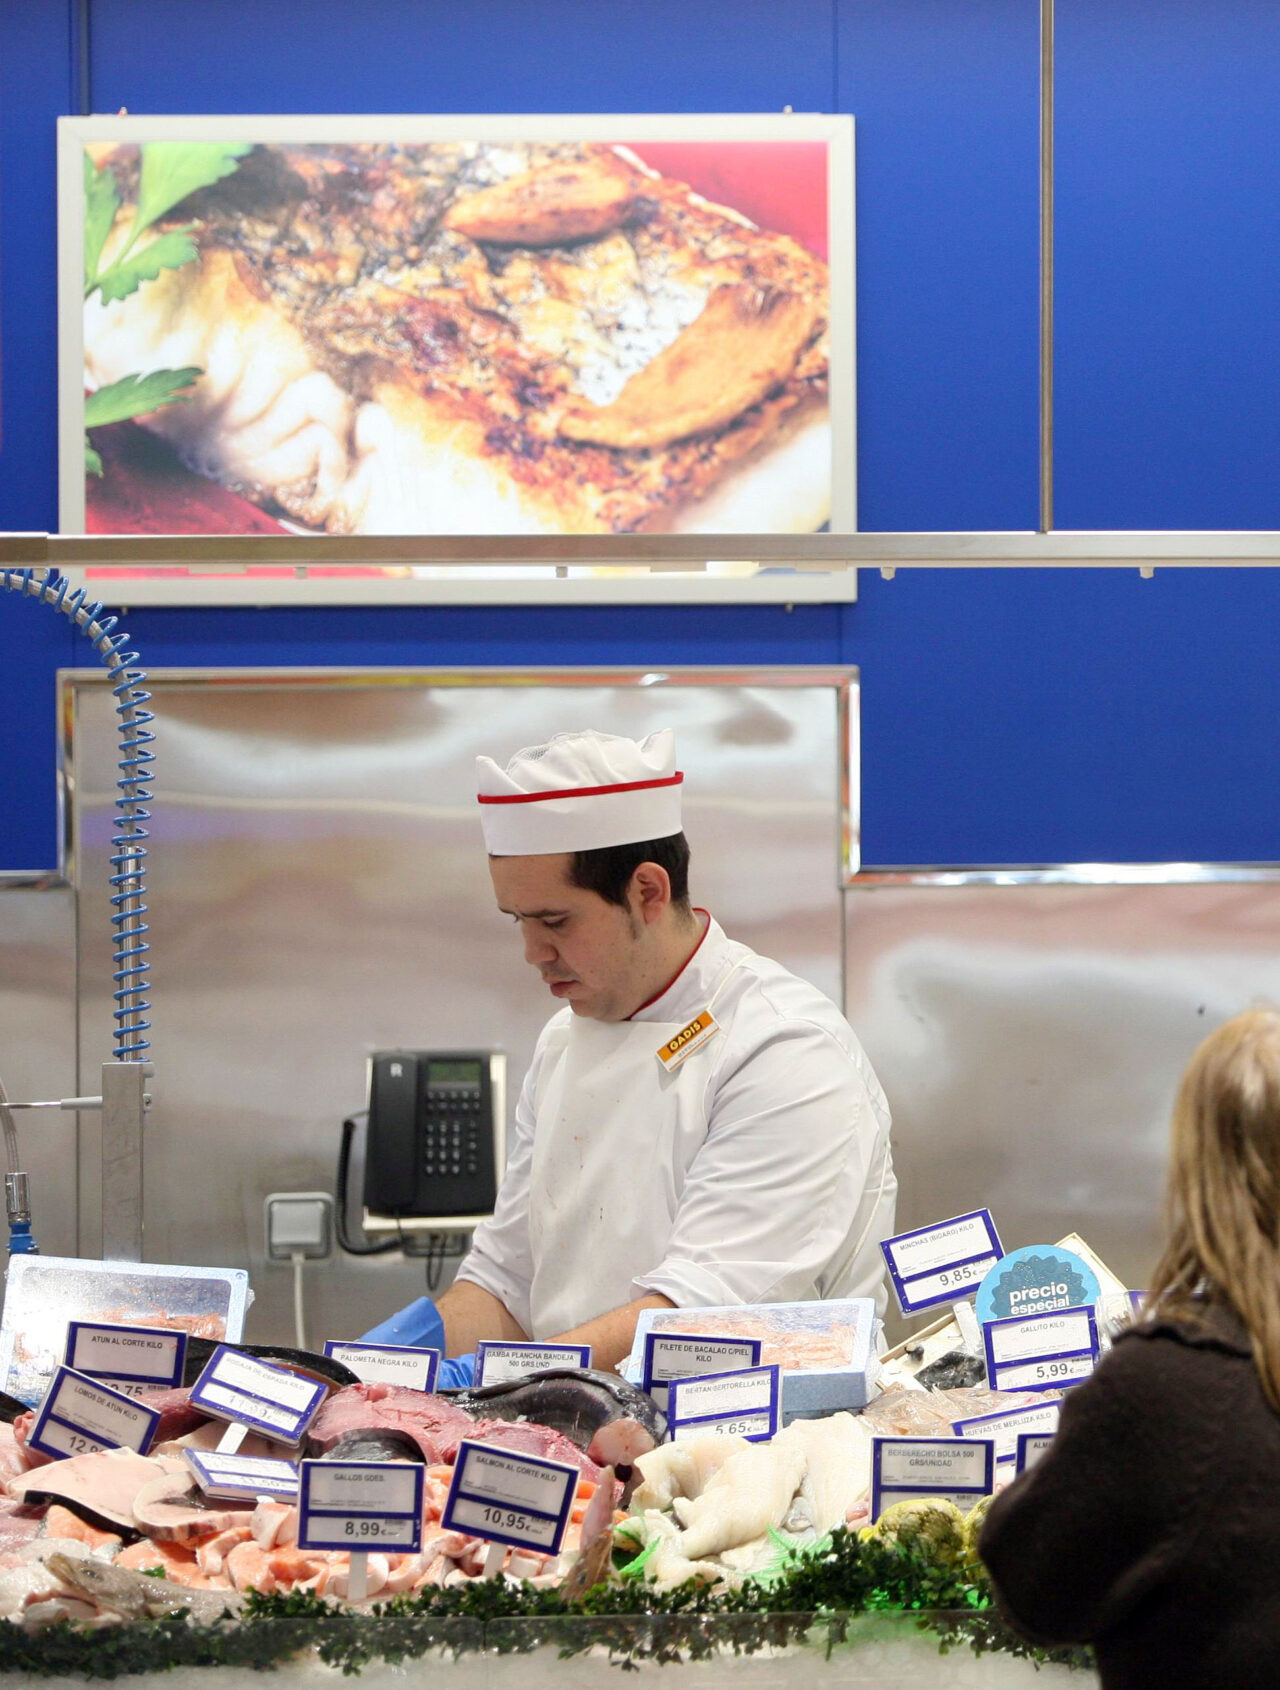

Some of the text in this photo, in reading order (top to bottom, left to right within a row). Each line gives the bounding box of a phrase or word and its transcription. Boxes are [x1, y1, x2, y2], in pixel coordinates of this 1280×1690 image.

[669, 1021, 701, 1051] GADIS
[959, 1223, 974, 1232] KILO
[1009, 1282, 1068, 1305] precio
[1010, 1295, 1070, 1314] especial
[1020, 1323, 1048, 1333] GALLITO
[91, 1336, 110, 1344] ATUN
[122, 1338, 145, 1348] CORTE
[146, 1341, 163, 1349] KILO
[660, 1343, 682, 1351] FILETE
[694, 1345, 726, 1354] BACALAO
[340, 1354, 418, 1368] PALOMETA NEGRA KILO
[486, 1350, 510, 1358] GAMBA
[511, 1351, 542, 1359] PLANCHA
[74, 1386, 96, 1401] LOMOS
[96, 1394, 106, 1405] DE
[106, 1398, 123, 1414] ATUN
[123, 1409, 138, 1421] KILO
[965, 1426, 992, 1436] HUEVAS
[993, 1422, 1003, 1432] DE
[1003, 1415, 1035, 1429] MERLUZA
[937, 1450, 961, 1458] BOLSA
[962, 1450, 974, 1458] 500
[476, 1456, 557, 1482] SALMON AL CORTE KILO
[334, 1472, 363, 1481] GALLOS
